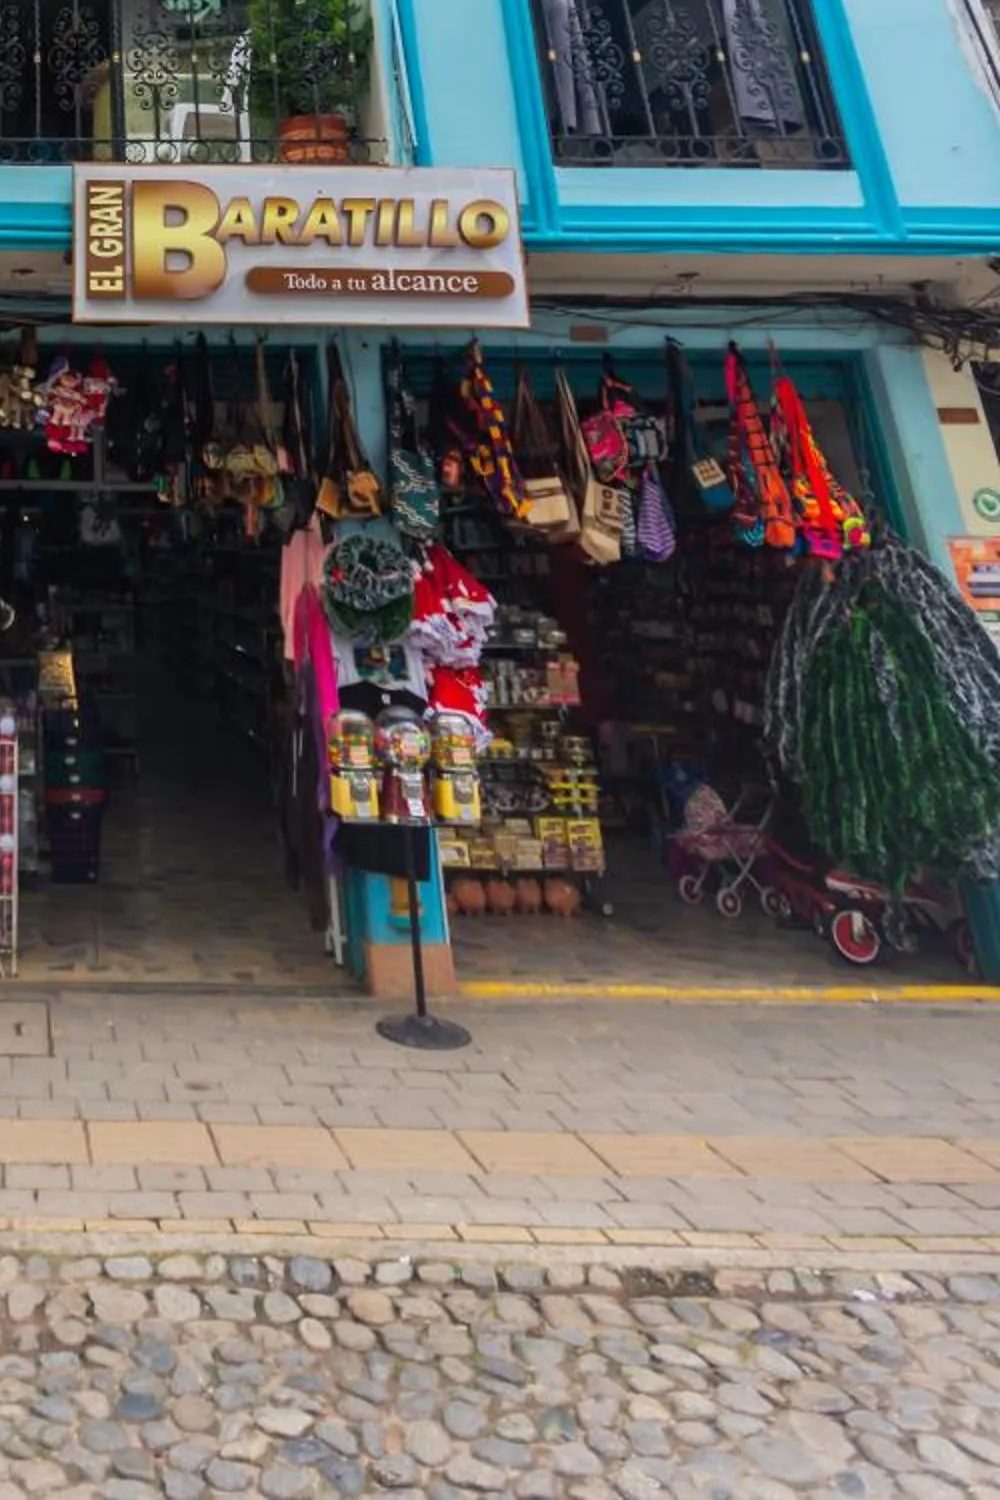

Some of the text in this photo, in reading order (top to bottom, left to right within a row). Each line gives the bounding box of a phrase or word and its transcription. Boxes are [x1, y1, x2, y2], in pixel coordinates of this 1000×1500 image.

[88, 185, 124, 292] EL GRAN
[132, 180, 511, 299] BARATILLO
[284, 268, 479, 293] Todo a tu alcance
